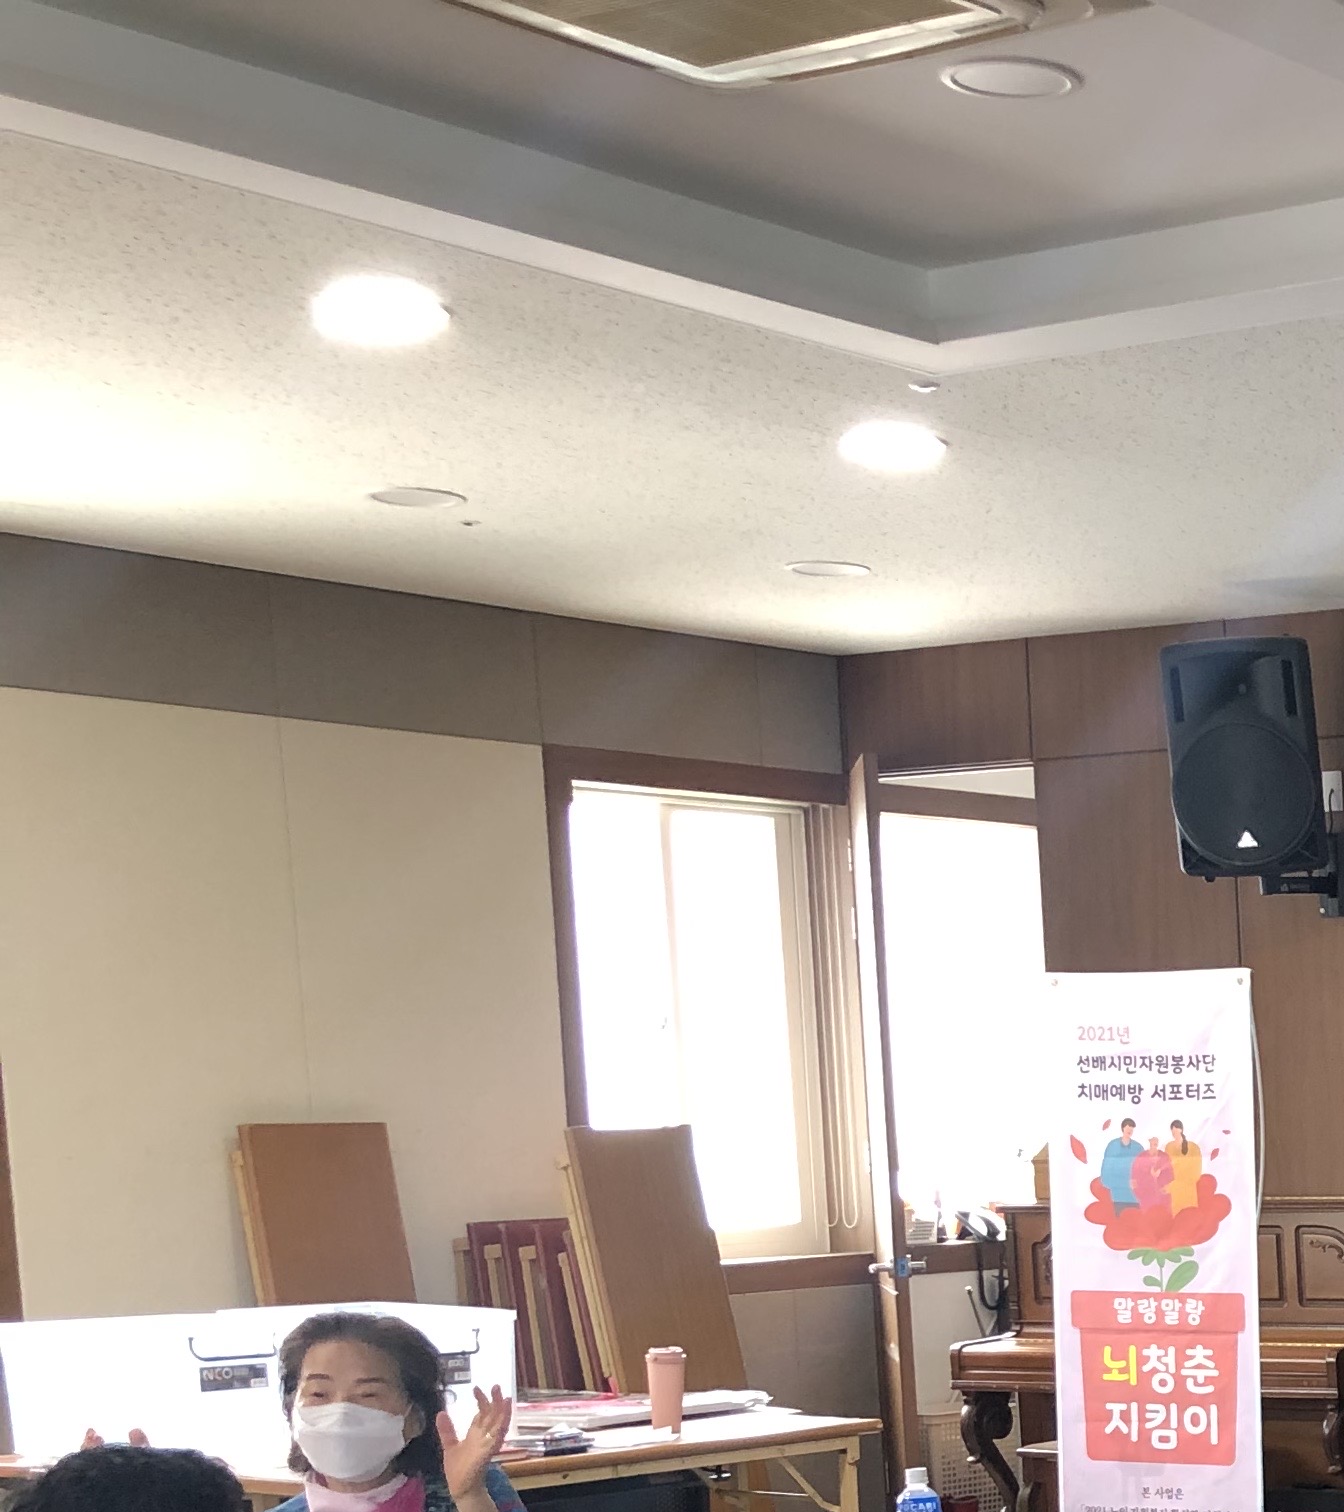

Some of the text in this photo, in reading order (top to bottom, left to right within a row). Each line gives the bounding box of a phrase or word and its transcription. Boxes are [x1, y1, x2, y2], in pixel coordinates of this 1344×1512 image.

[1077, 1025, 1131, 1044] 2021년
[1077, 1054, 1217, 1075] 선배시민자원봉사단
[1077, 1083, 1217, 1105] 치매예방 서포터즈
[1113, 1297, 1206, 1327] 말랑말랑
[1102, 1343, 1220, 1395] 뇌청춘
[1103, 1401, 1219, 1451] 지킴이
[1141, 1486, 1185, 1501] 본 사업은
